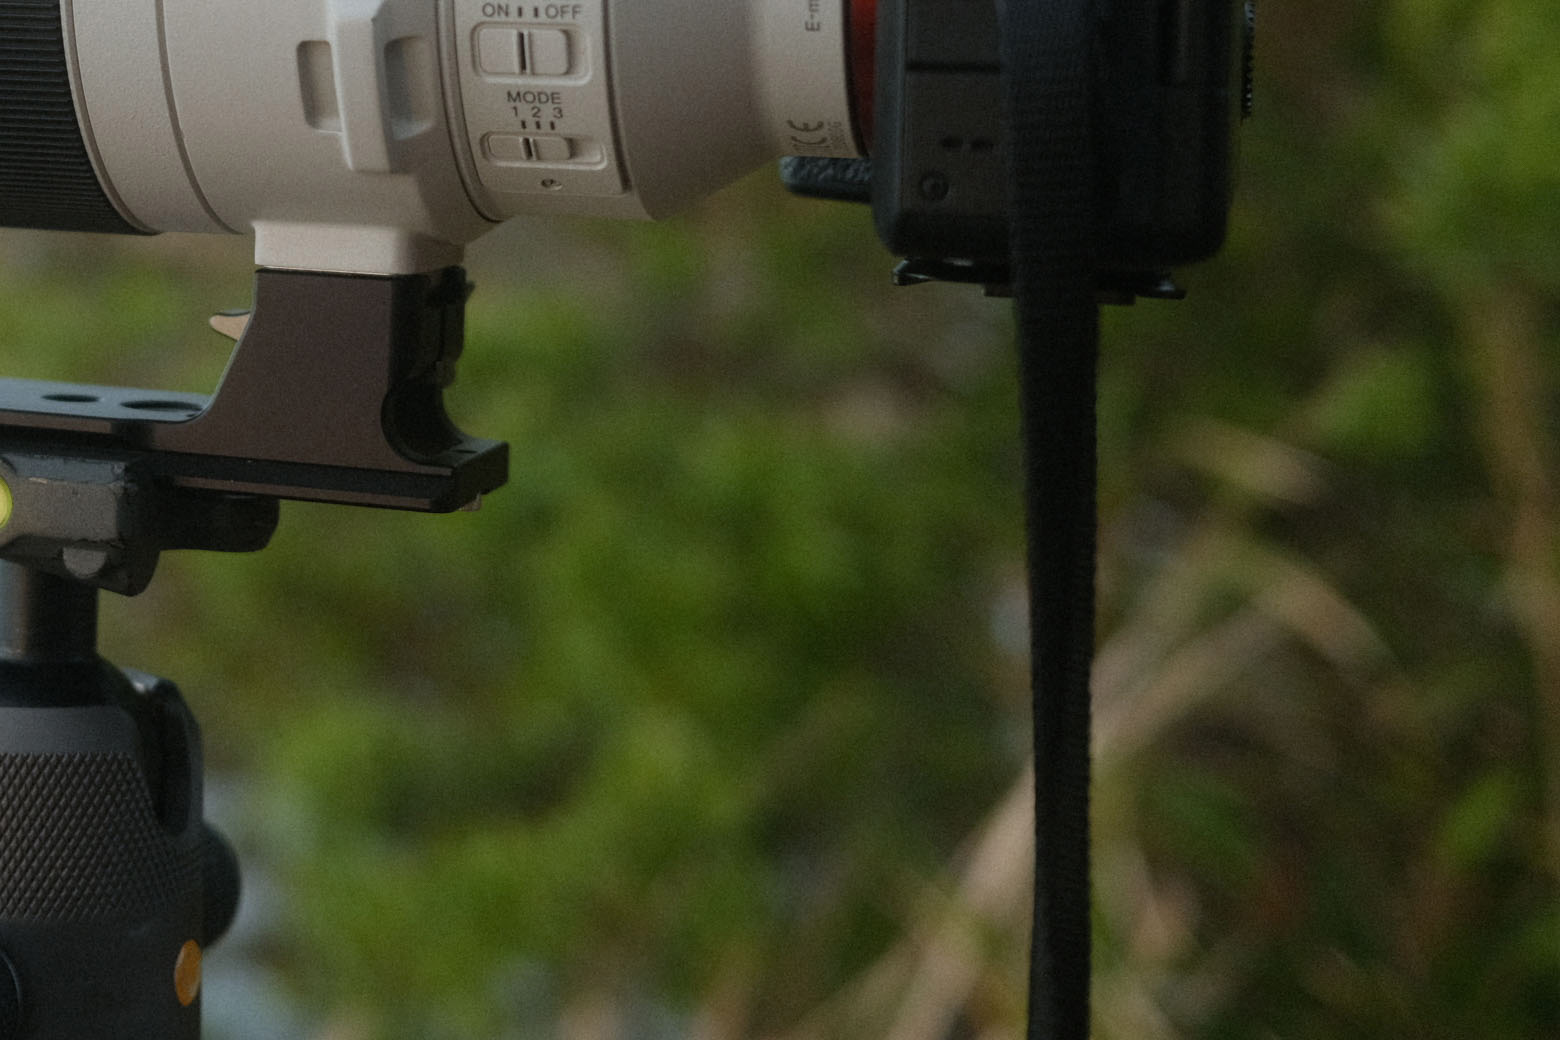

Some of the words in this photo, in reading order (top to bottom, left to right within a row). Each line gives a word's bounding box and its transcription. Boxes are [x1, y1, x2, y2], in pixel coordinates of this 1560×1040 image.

[482, 2, 510, 18] ON
[544, 3, 582, 20] OFF
[506, 90, 562, 105] MODE
[531, 105, 542, 119] 2
[552, 106, 565, 120] 3
